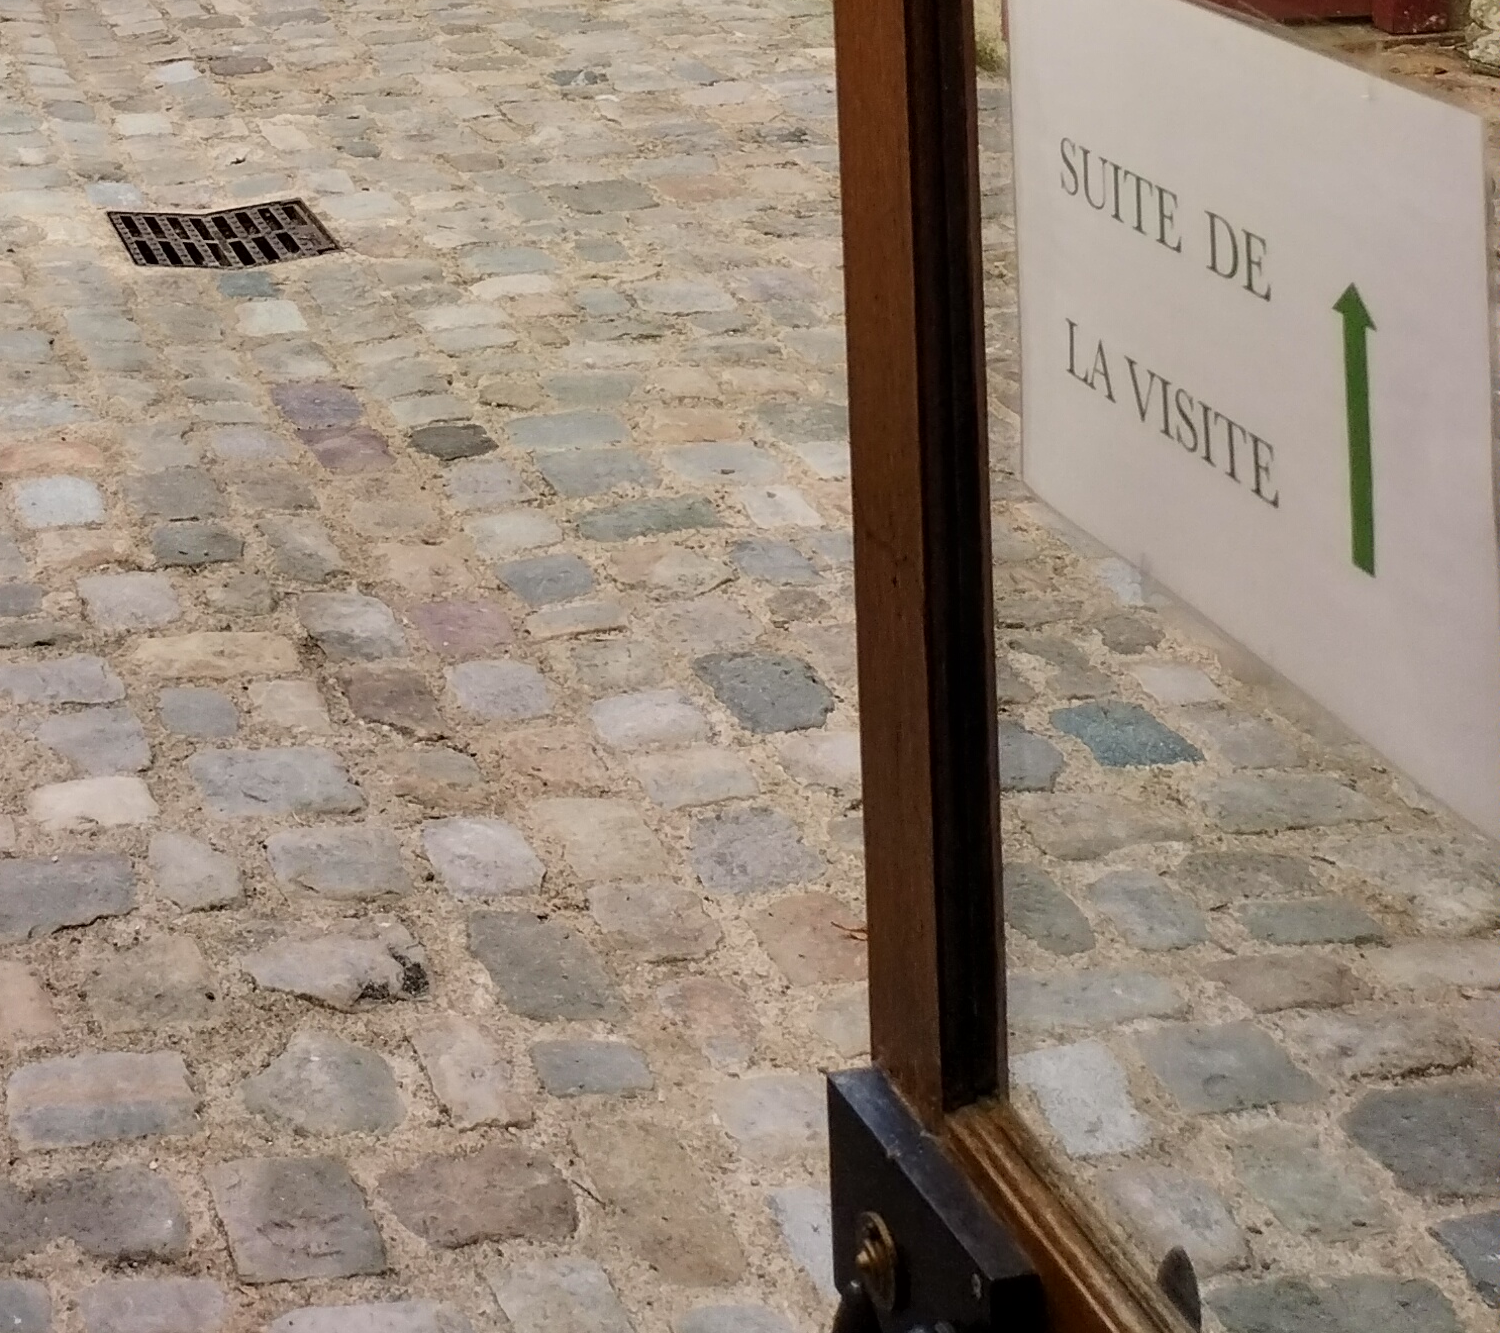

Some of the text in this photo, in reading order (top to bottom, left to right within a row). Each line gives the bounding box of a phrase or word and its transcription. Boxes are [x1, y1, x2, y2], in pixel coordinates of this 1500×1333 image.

[1060, 137, 1271, 302] SUITE DE
[1065, 317, 1279, 509] LA VISITE
